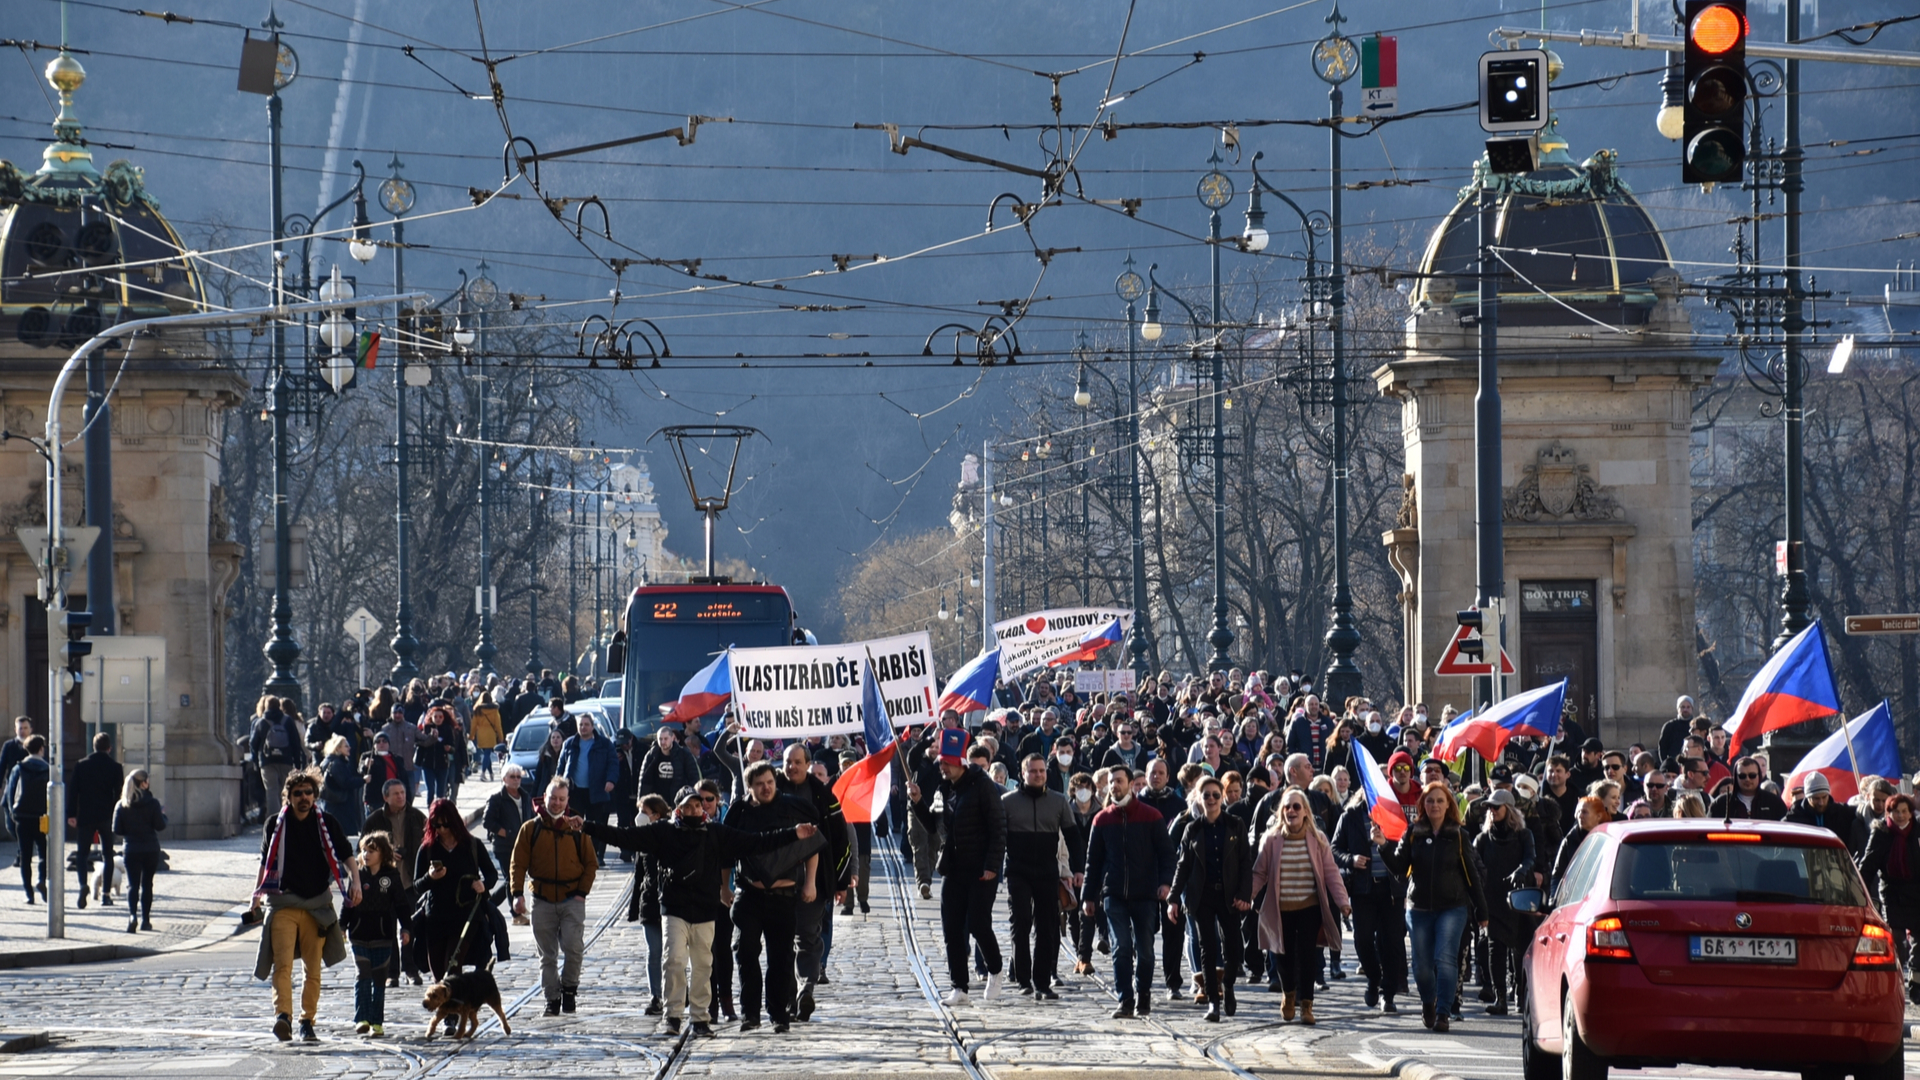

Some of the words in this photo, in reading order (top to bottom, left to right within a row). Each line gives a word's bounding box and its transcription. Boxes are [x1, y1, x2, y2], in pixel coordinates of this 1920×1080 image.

[1368, 89, 1382, 100] KT
[1525, 590, 1554, 600] BOAT
[1556, 590, 1589, 599] TRIPS
[653, 602, 678, 619] 22
[996, 621, 1026, 640] VLÁDA
[1048, 610, 1099, 632] NOUZOVÝ
[1041, 645, 1064, 661] střet
[735, 656, 860, 692] VLASTIZRÁDČE
[745, 710, 772, 729] NECH
[775, 705, 804, 729] NAŠI
[807, 707, 833, 727] ZEM
[837, 701, 854, 724] UŽ
[857, 703, 865, 722] N
[885, 695, 923, 719] OKOJI
[1829, 924, 1856, 933] FABIA
